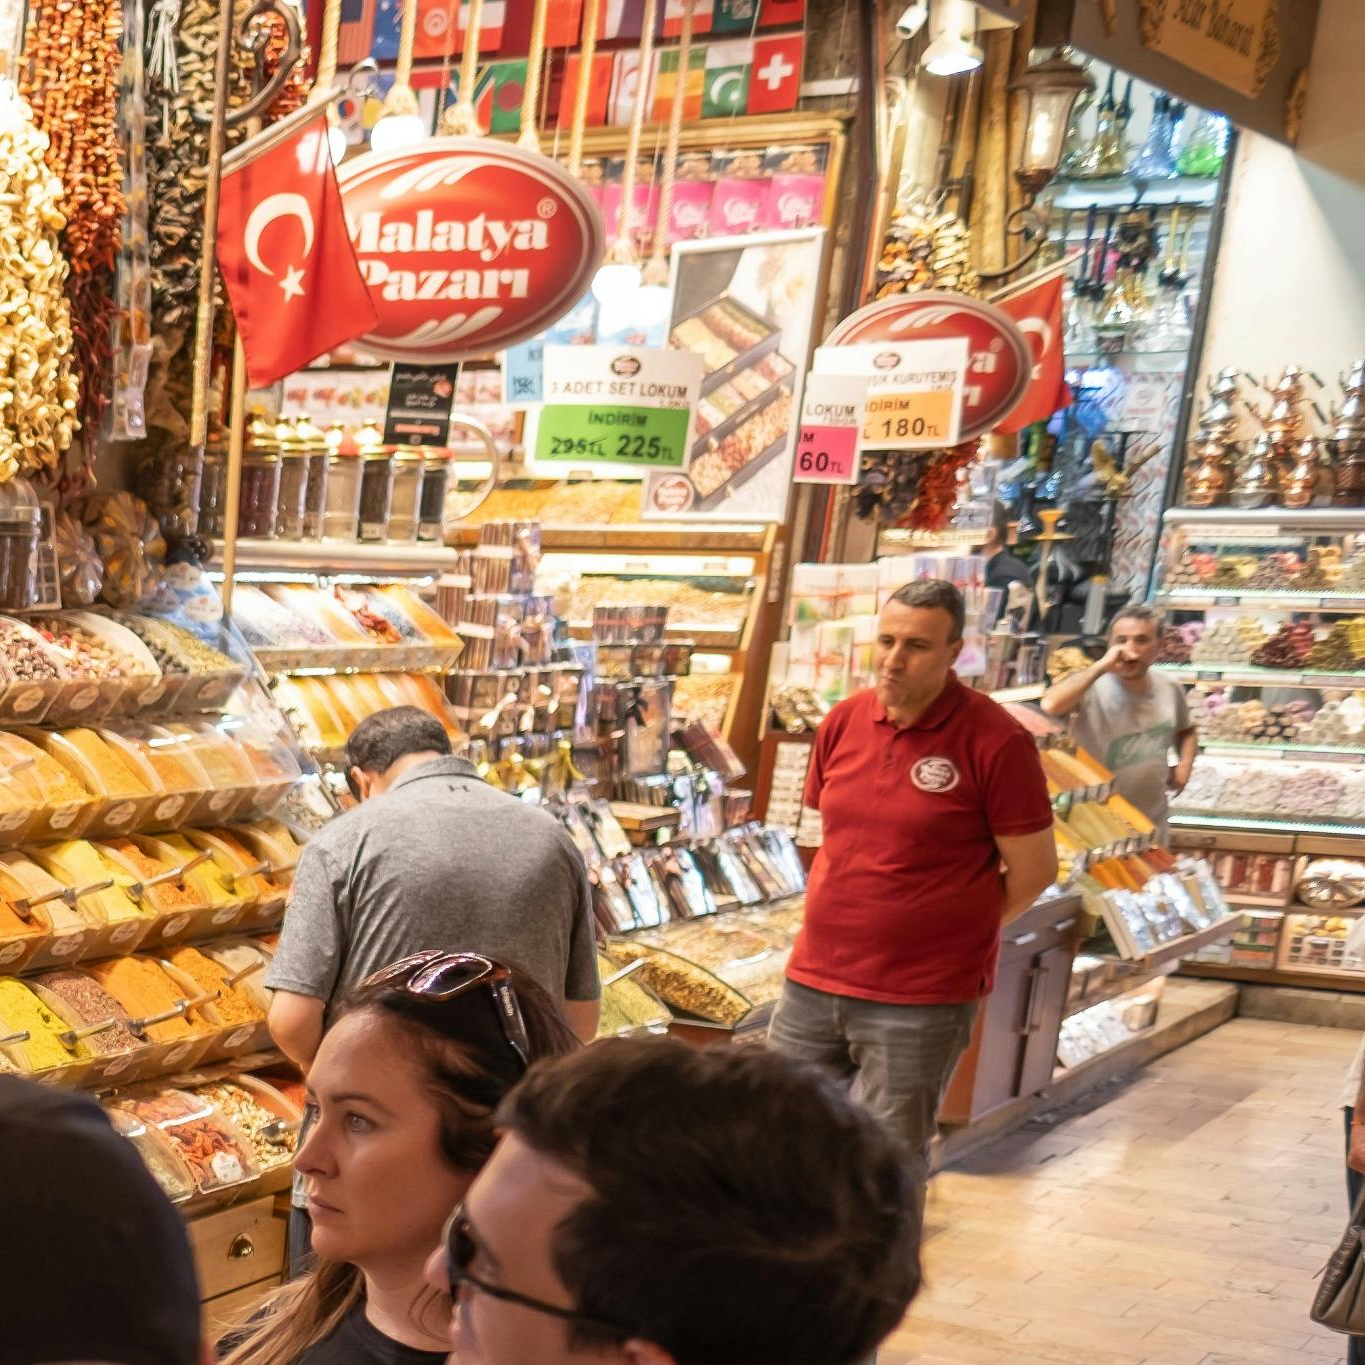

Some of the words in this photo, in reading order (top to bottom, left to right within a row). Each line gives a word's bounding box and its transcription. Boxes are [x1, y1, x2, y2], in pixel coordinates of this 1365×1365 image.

[344, 208, 550, 263] Malatya
[358, 259, 530, 301] Pazarı
[563, 382, 602, 394] ADET
[608, 382, 635, 395] SET
[639, 383, 688, 399] LOKUM
[588, 409, 648, 427] İNDİRİM
[805, 403, 856, 417] LOKUM
